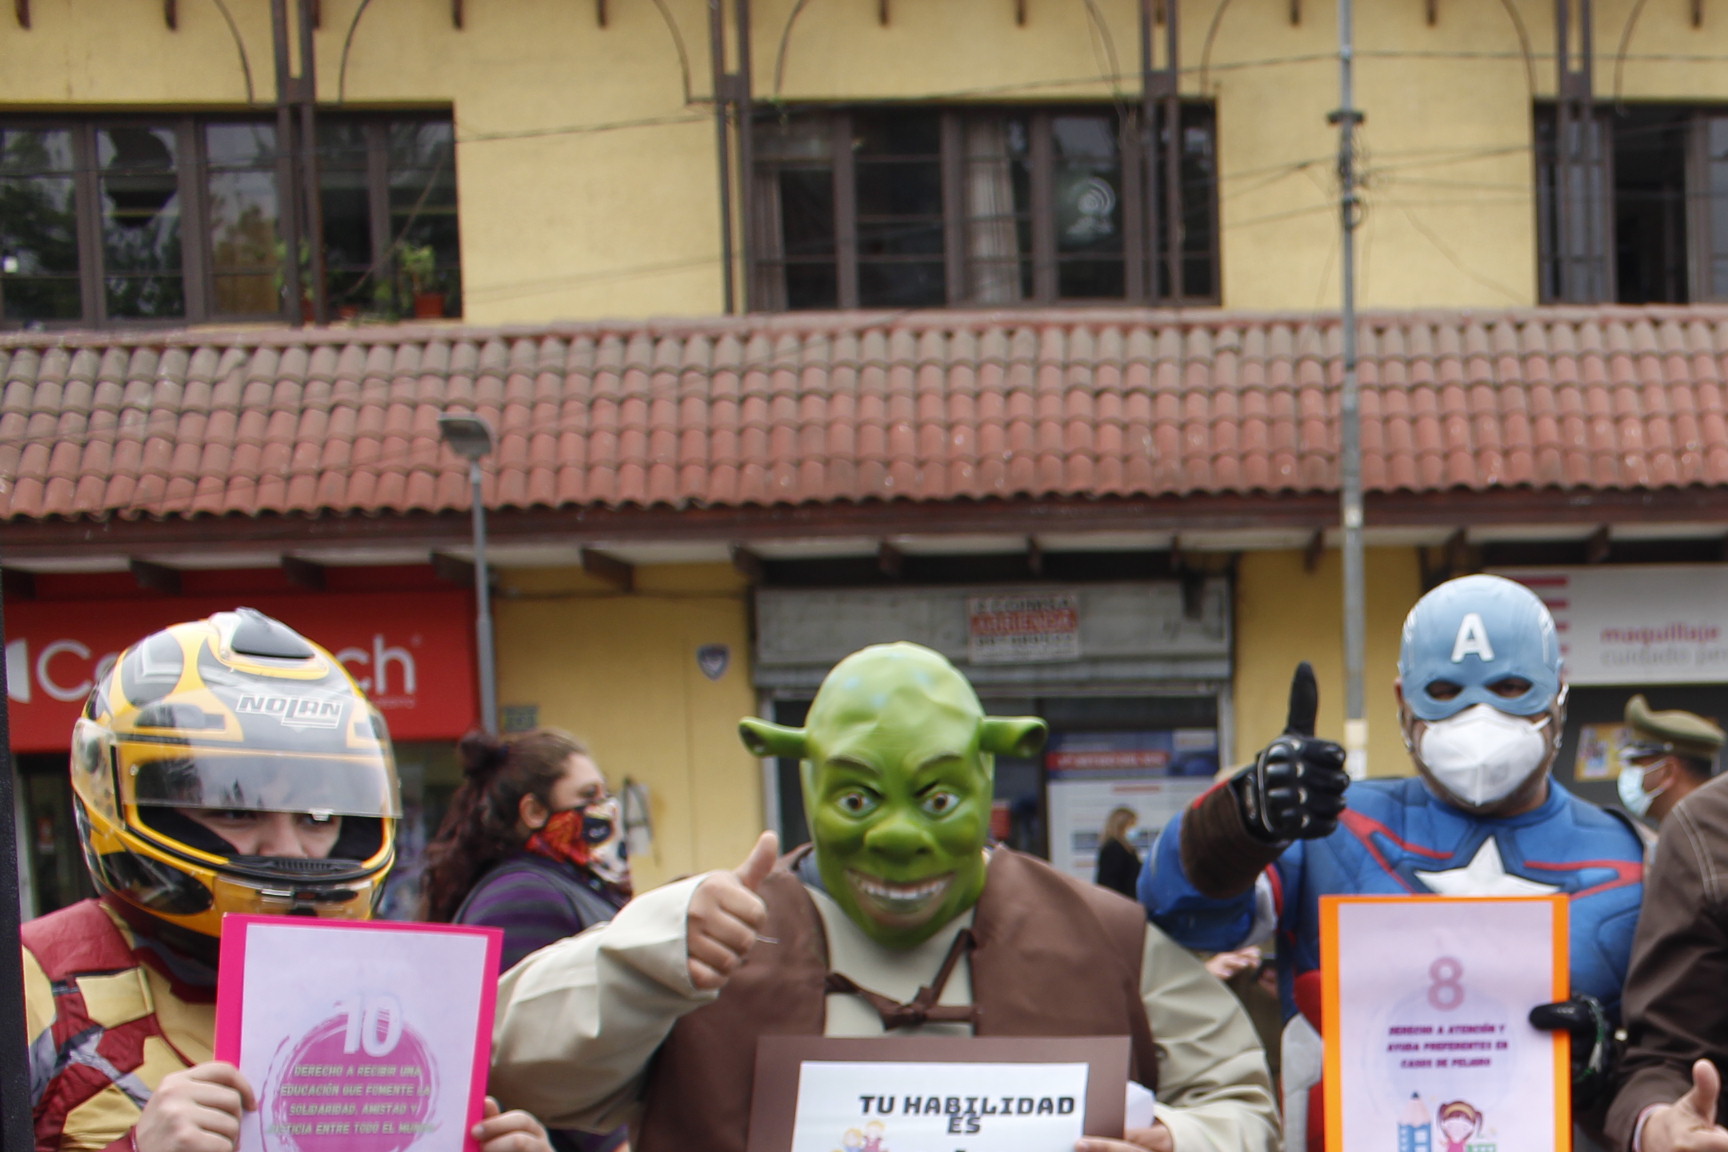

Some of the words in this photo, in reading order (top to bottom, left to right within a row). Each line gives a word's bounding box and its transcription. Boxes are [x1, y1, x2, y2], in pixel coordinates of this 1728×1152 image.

[1451, 612, 1495, 663] A
[238, 695, 341, 720] NOLAN
[1427, 956, 1465, 1011] 8
[336, 994, 403, 1057] 10
[294, 1065, 343, 1077] DERECHO
[346, 1066, 354, 1077] A
[357, 1066, 397, 1077] RECIBIR
[399, 1067, 422, 1077] UNA
[280, 1083, 339, 1097] EDUCACIÓN
[342, 1085, 363, 1097] QUE
[365, 1085, 415, 1097] FOMENTE
[417, 1085, 432, 1096] LA
[362, 1104, 407, 1116] AMISTAD
[410, 1105, 418, 1115] Y
[859, 1095, 896, 1114] TU
[903, 1096, 1075, 1115] HABILIDAD
[266, 1123, 312, 1135] JUSTICIA
[316, 1123, 350, 1135] ENTRE
[354, 1123, 380, 1135] TODO
[383, 1123, 395, 1134] EL
[947, 1115, 981, 1134] ES
